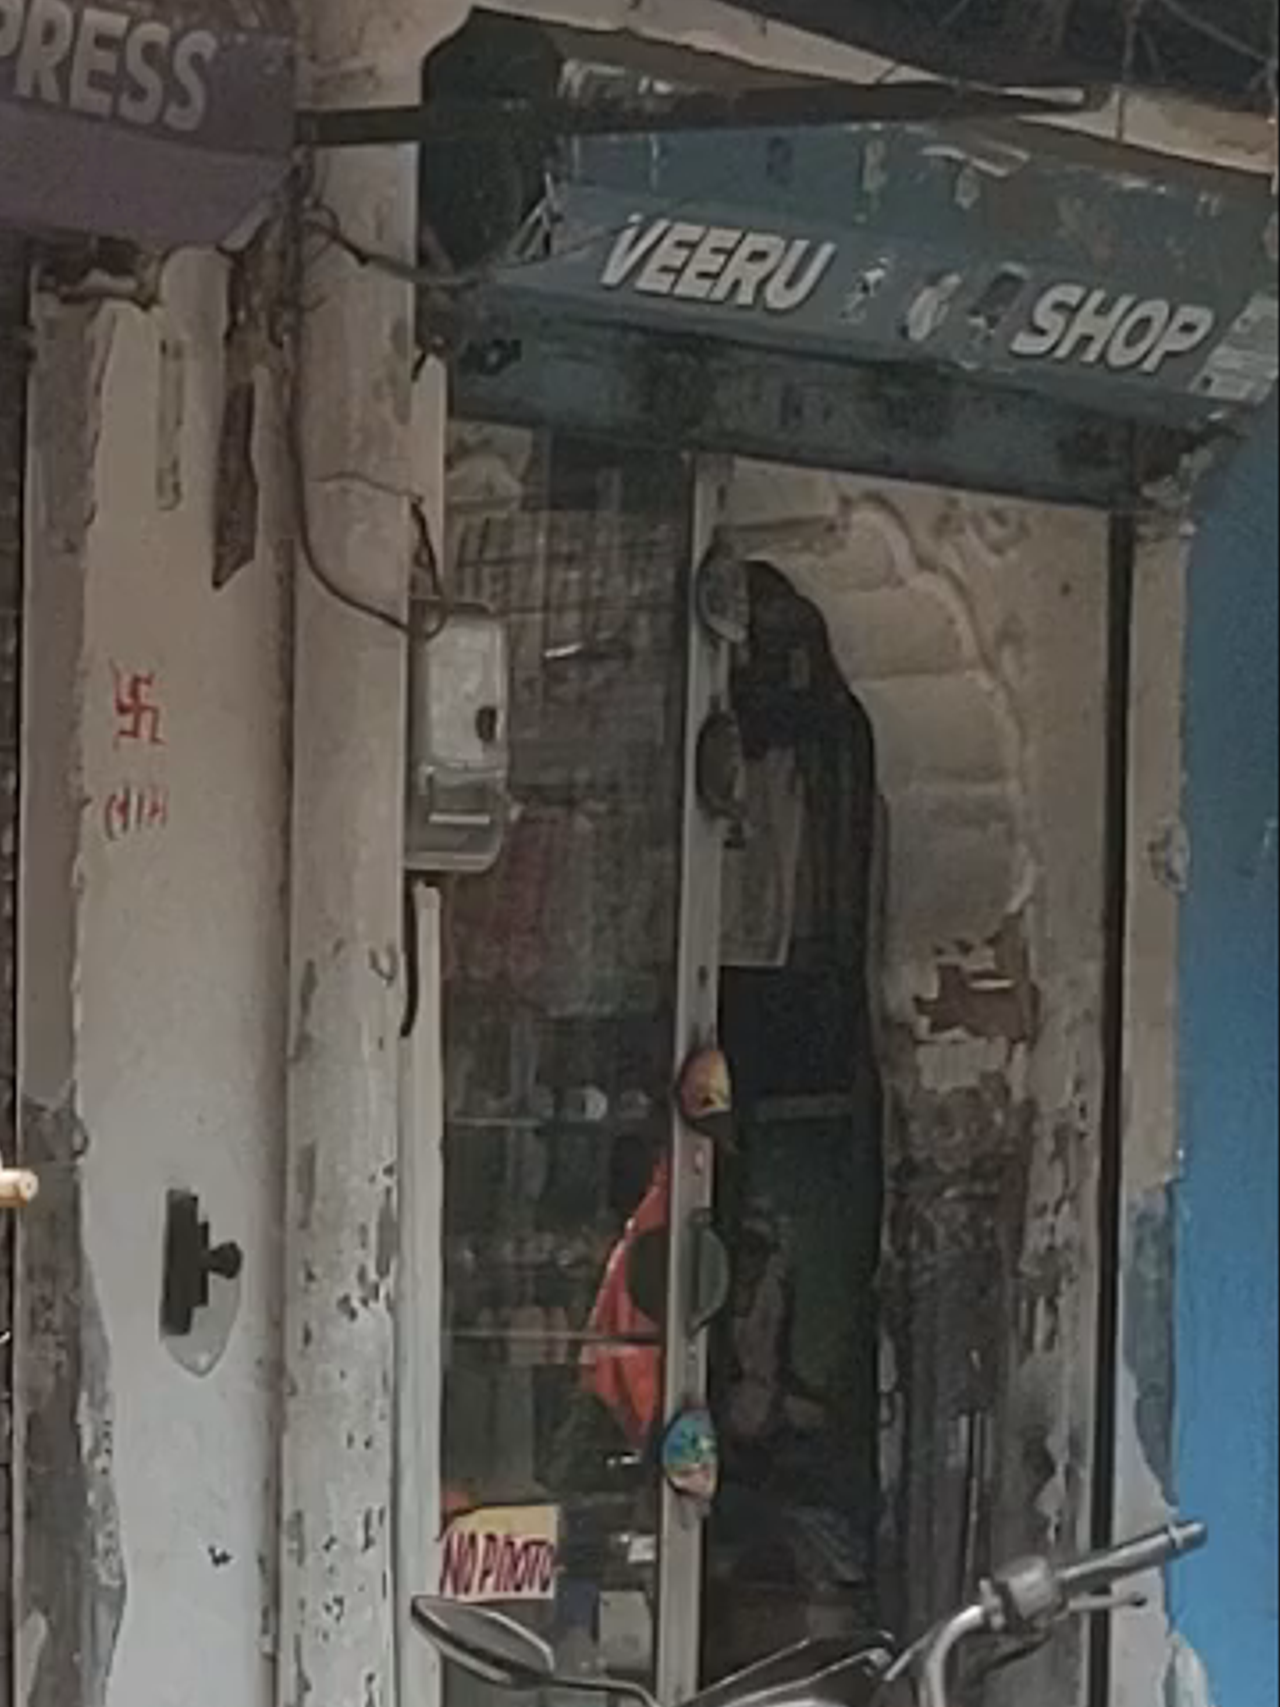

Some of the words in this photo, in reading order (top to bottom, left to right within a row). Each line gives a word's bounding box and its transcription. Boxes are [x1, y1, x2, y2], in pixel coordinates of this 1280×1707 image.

[600, 214, 837, 312] VEERU
[1010, 284, 1216, 374] SHOP
[441, 1529, 477, 1594] NO
